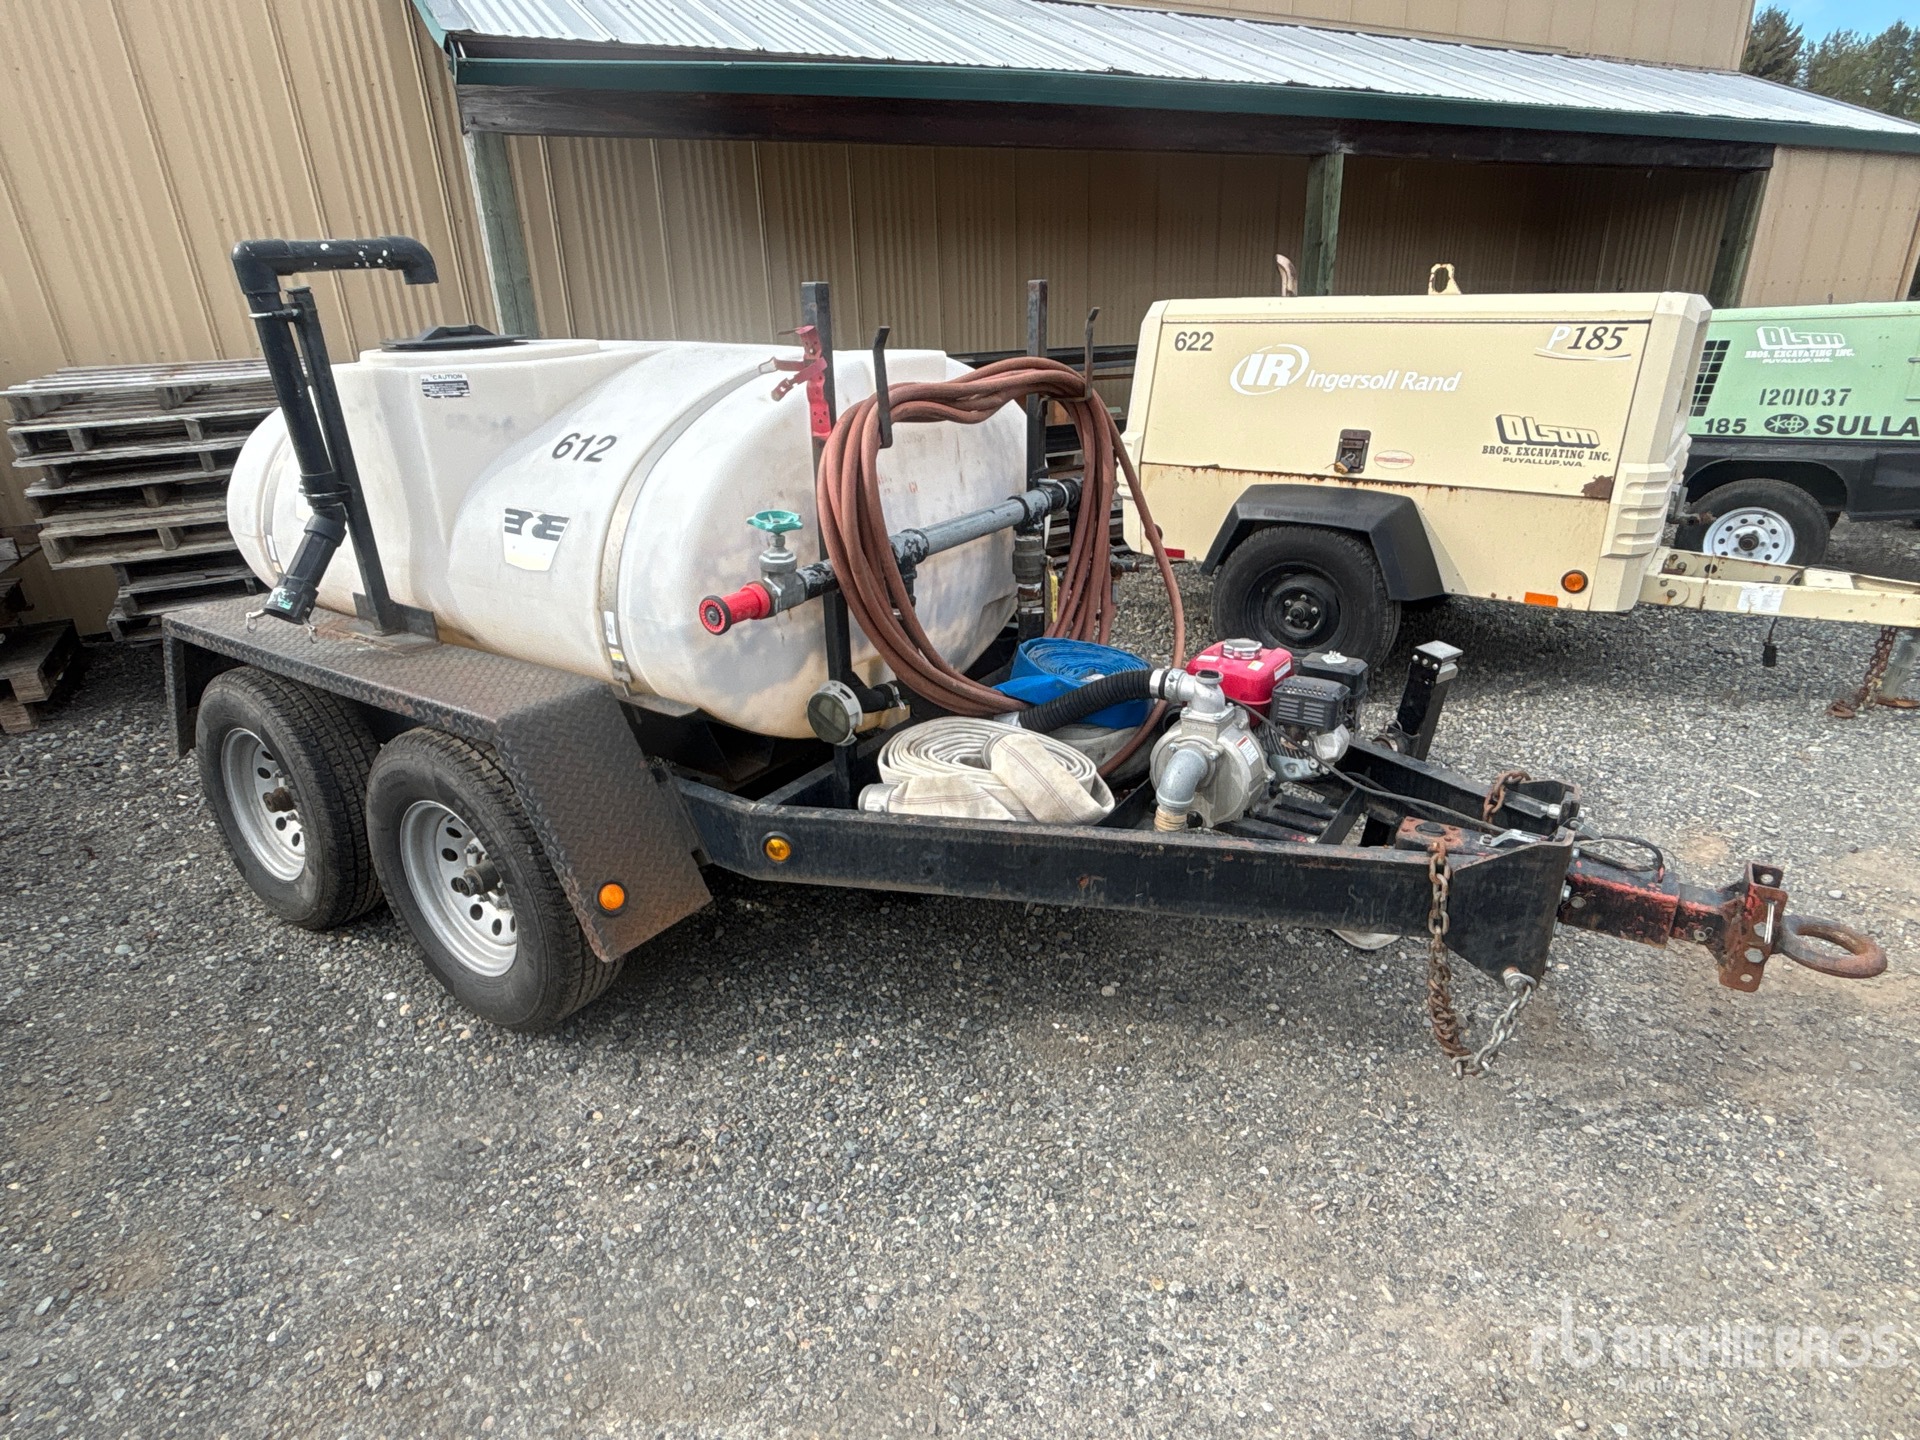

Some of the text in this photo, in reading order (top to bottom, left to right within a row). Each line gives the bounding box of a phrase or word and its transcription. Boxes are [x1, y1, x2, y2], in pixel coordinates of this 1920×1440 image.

[1174, 331, 1214, 352] 622
[1545, 325, 1629, 351] P185
[1756, 326, 1846, 350] Olson
[1773, 349, 1833, 358] EXCAVATING
[1241, 353, 1297, 387] IR
[1305, 369, 1463, 393] Ingersoll Rand
[1759, 388, 1852, 407] 1201037
[1495, 413, 1601, 449] Olson
[1704, 414, 1920, 436] 185 SULLA
[551, 432, 618, 463] 612
[1481, 445, 1612, 462] BROS. EXCAVATING INC.
